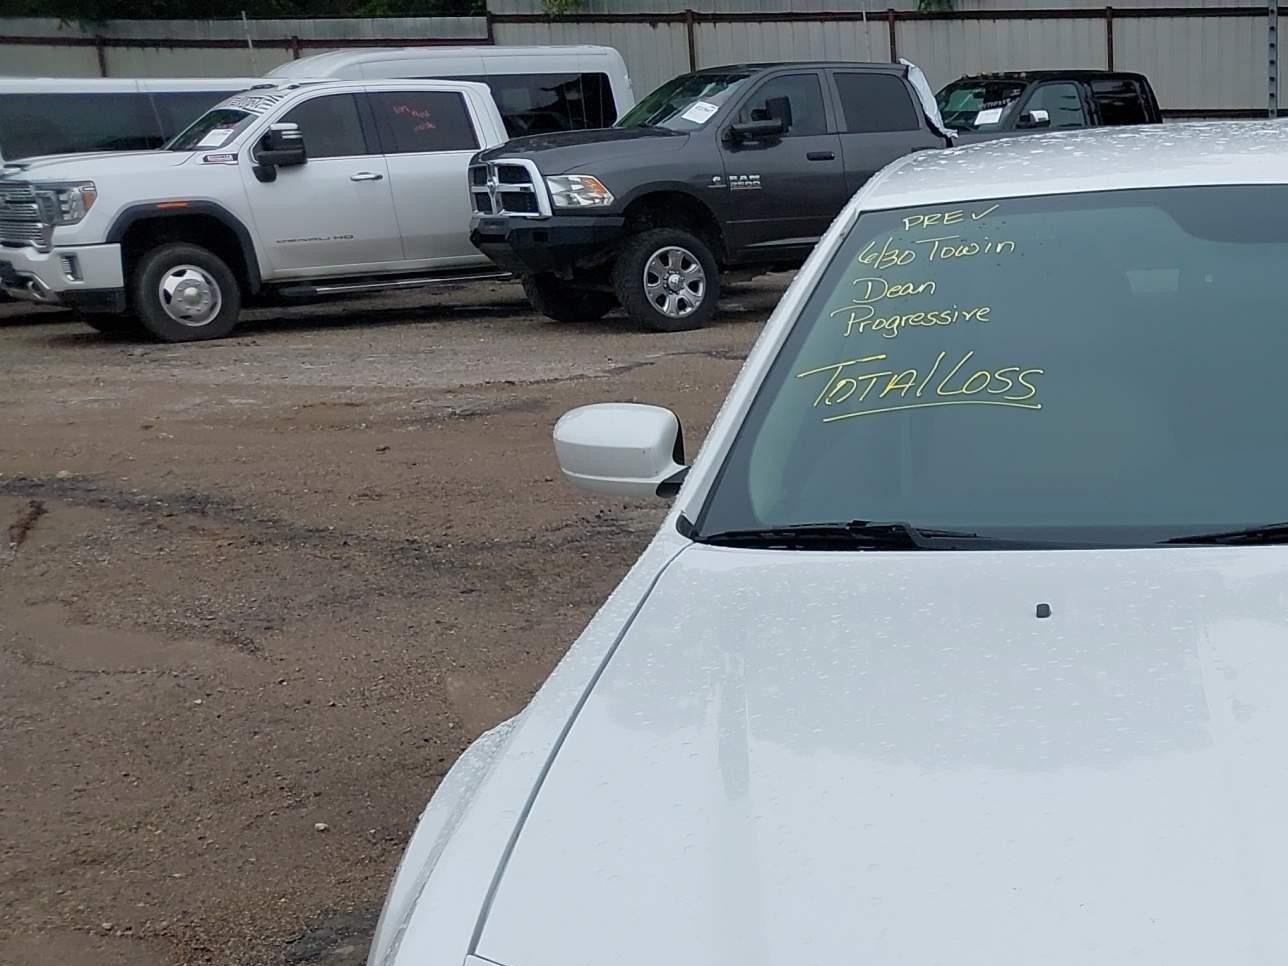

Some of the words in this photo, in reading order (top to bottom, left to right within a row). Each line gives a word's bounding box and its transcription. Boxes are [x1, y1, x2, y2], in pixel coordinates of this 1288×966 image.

[858, 237, 916, 269] 6/30
[852, 278, 936, 303] Dean
[830, 305, 991, 337] Progressive
